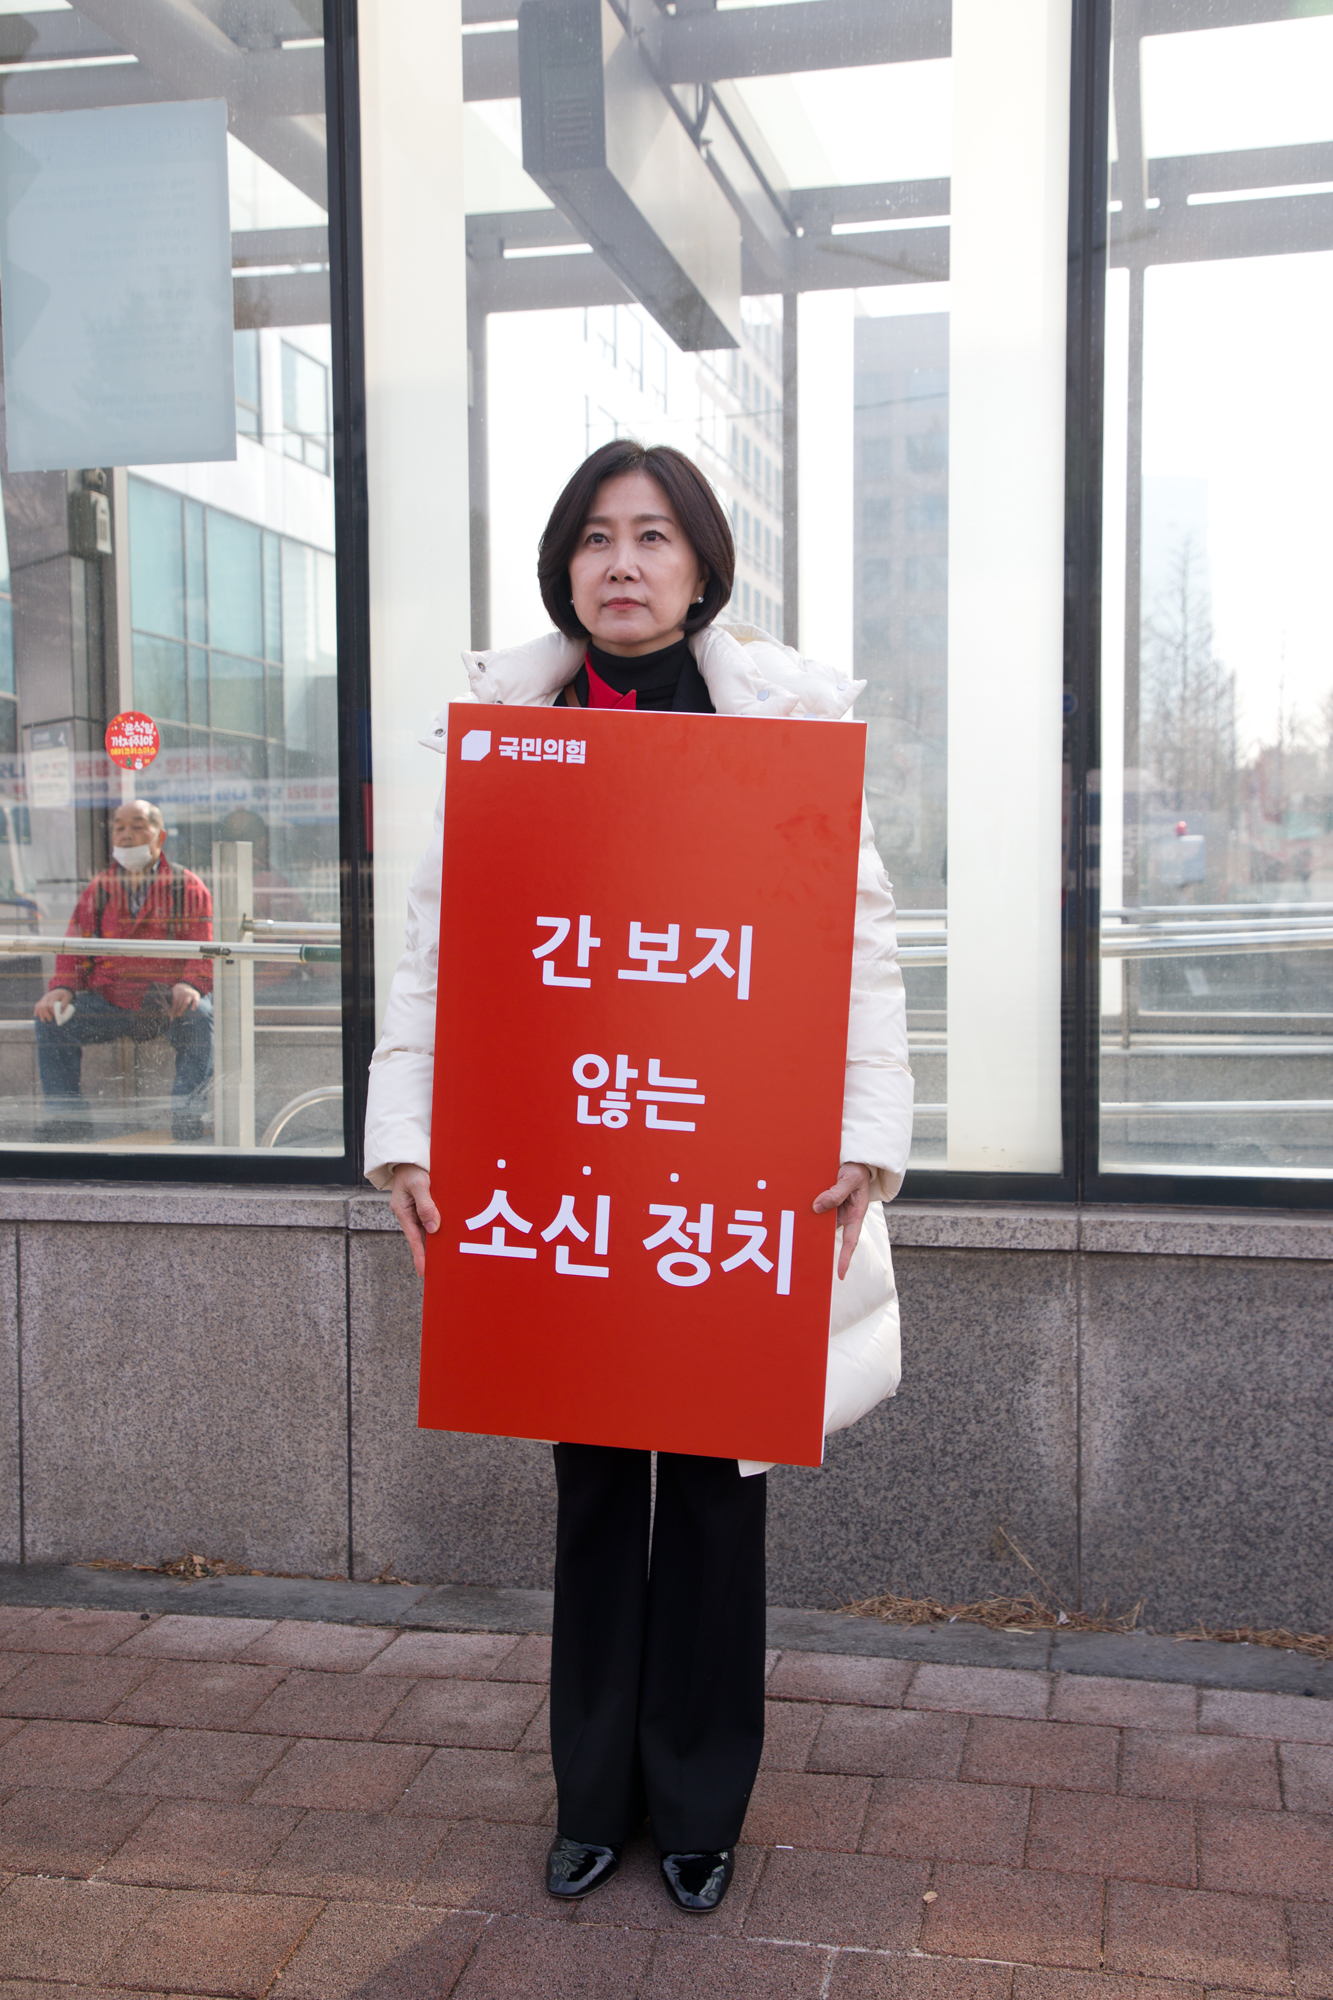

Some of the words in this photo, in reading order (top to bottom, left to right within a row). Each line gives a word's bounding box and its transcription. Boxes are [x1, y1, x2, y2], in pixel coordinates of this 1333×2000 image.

[499, 737, 586, 764] 국민의힘
[532, 915, 600, 988] 간
[618, 922, 753, 1000] 보지
[573, 1054, 705, 1131] 않는
[460, 1190, 610, 1277] 소신
[643, 1204, 794, 1295] 정치
